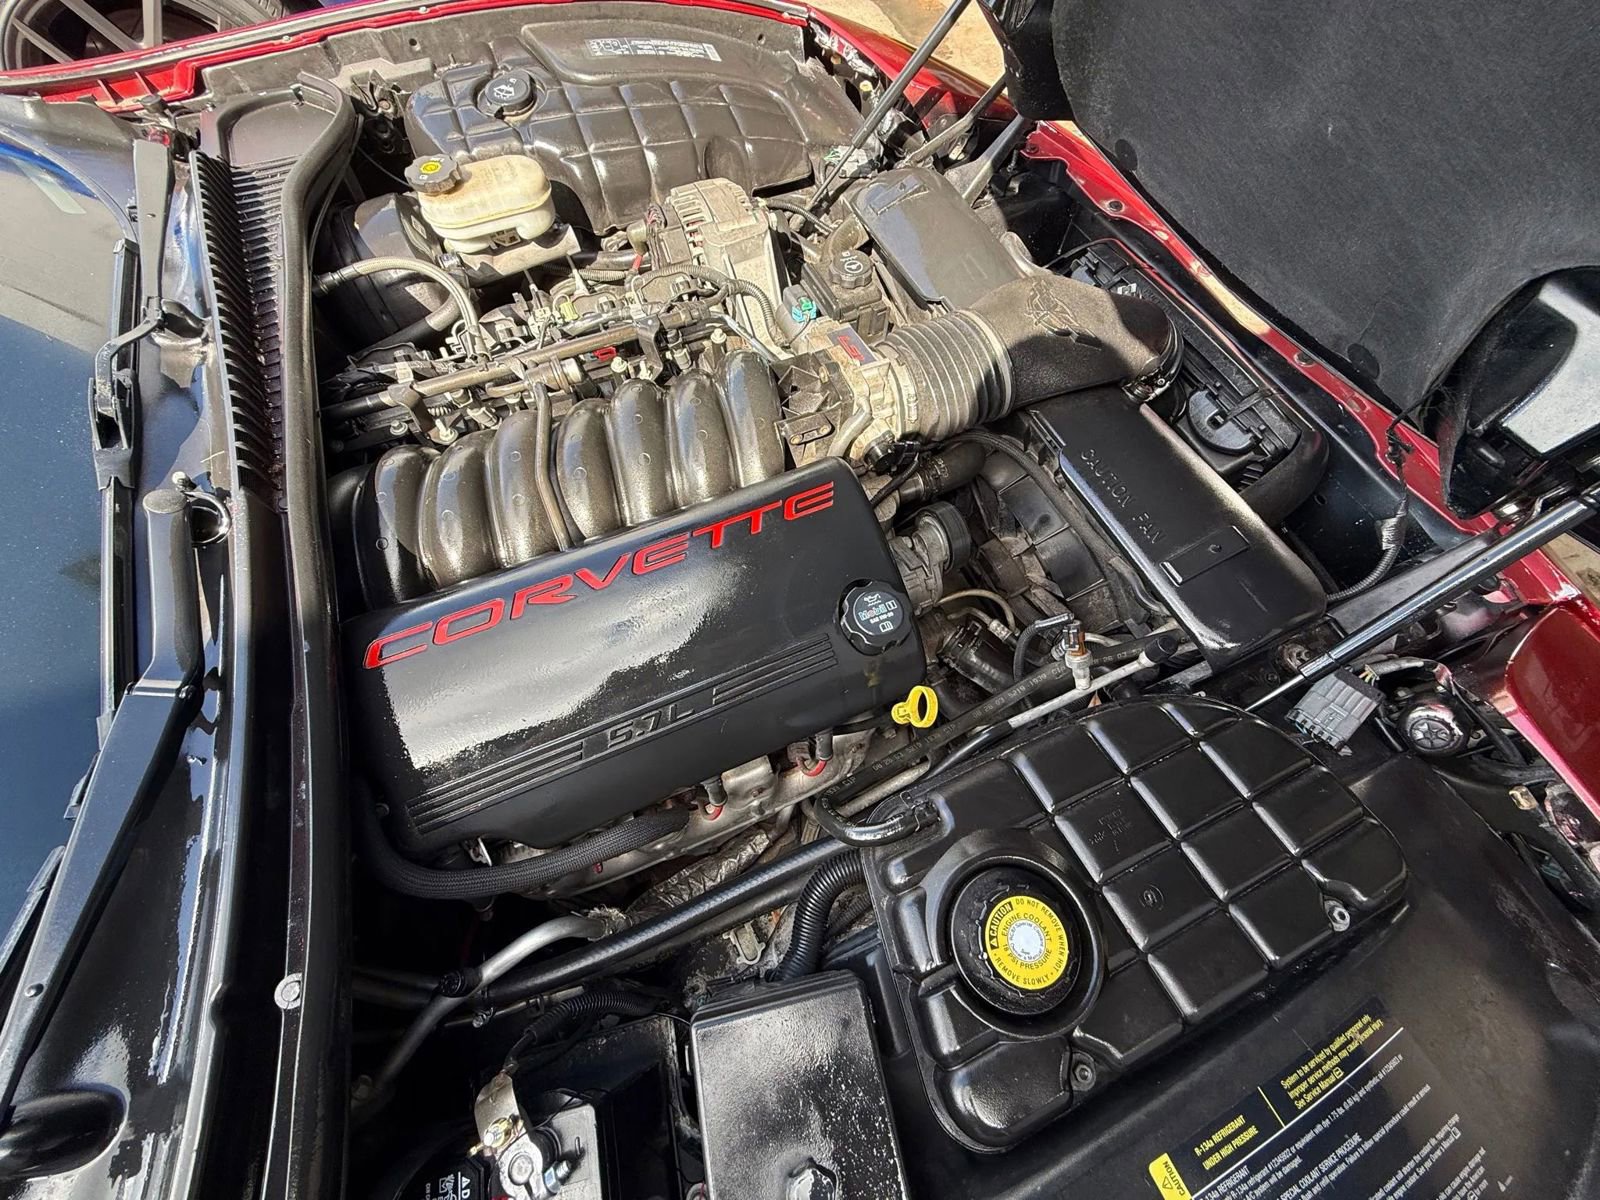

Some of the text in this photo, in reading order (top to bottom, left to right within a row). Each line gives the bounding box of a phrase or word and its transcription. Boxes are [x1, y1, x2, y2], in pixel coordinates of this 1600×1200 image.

[1080, 449, 1166, 544] CAUTION FAN
[363, 481, 834, 669] CORVETTE
[606, 703, 695, 749] 5.7L
[990, 898, 1066, 973] CAUTION DO NOT REMOVE WHEN HOT
[1002, 912, 1022, 937] ENGINE
[1023, 912, 1052, 943] COOLANT
[994, 956, 1050, 986] REMOVE SLOWLY
[1008, 952, 1019, 965] PSI
[1020, 948, 1052, 969] PRESSURE
[1281, 1073, 1299, 1089] System
[1295, 1099, 1306, 1109] See
[1303, 1086, 1321, 1102] Service
[1194, 1115, 1245, 1156] R-134a REFRIGERANT
[1203, 1126, 1258, 1170] UNDER HIGH PRESSURE
[1163, 1161, 1185, 1196] CAUTION
[1217, 1165, 1249, 1193] REFRIGERANT
[1299, 1167, 1321, 1188] COOLANT
[1319, 1153, 1338, 1172] SERVICE
[1336, 1133, 1362, 1157] PROCEDURE
